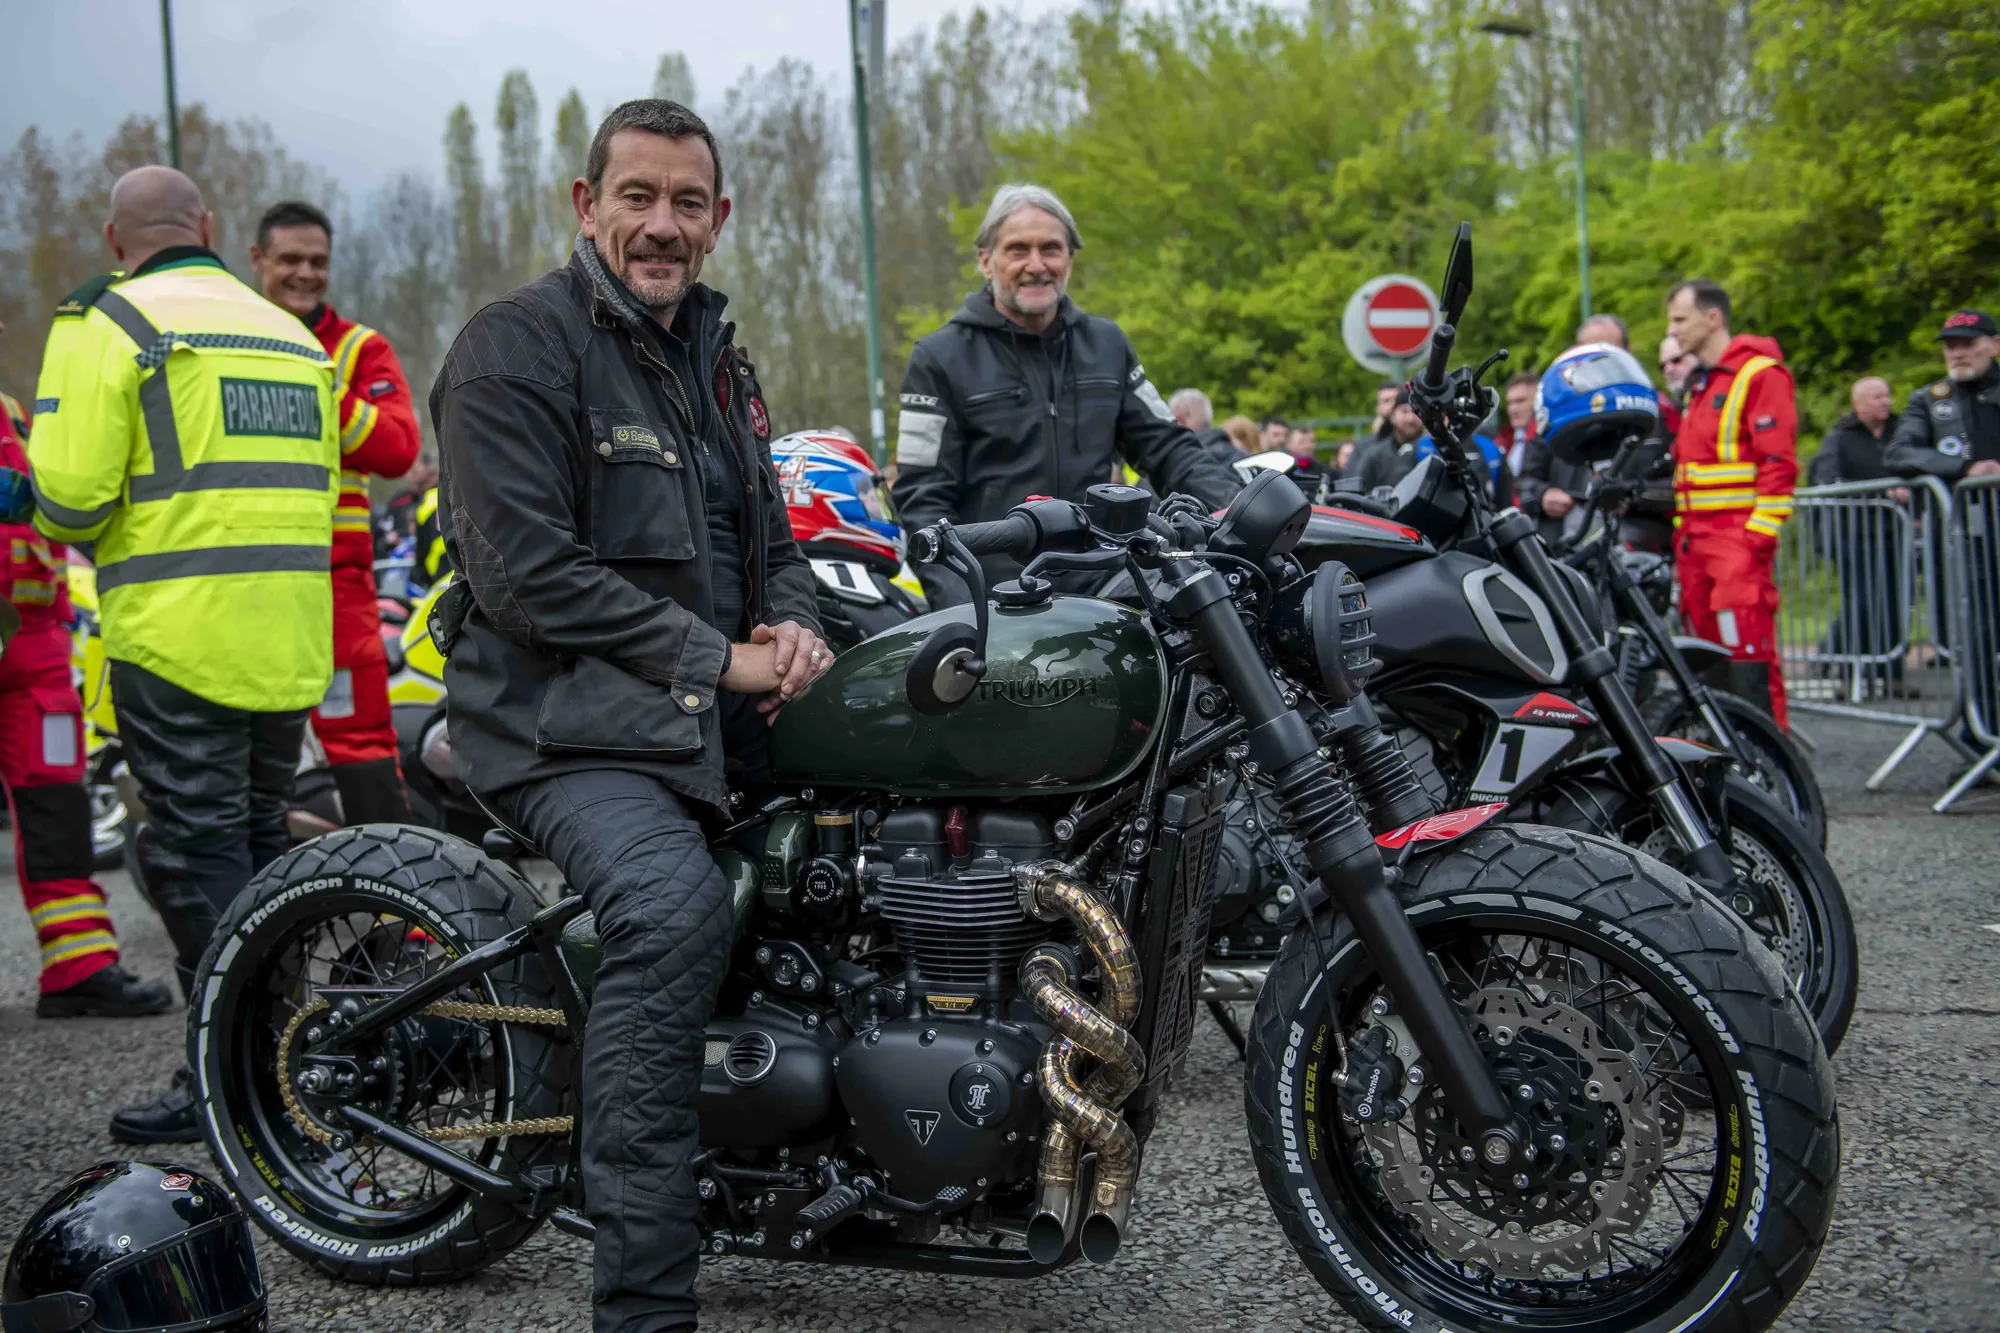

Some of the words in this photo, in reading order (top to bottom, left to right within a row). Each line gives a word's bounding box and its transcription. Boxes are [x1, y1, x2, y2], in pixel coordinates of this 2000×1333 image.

[223, 383, 319, 434] PARAMEDIC
[978, 677, 1098, 701] TRIUMPH
[1499, 728, 1526, 784] 1
[1469, 792, 1509, 803] DUCATI
[240, 877, 343, 935] Thornton
[355, 878, 458, 937] Hundred
[1277, 1020, 1305, 1174] Hundred
[1305, 1061, 1318, 1113] EXCEL
[1364, 1068, 1380, 1104] brembo
[1599, 920, 1740, 1054] Thornton
[1737, 1069, 1770, 1243] Hundred
[1724, 1153, 1742, 1209] EXCEL
[254, 1195, 359, 1257] Hundred
[366, 1201, 473, 1258] Thornton
[1298, 1187, 1414, 1327] Thornton
